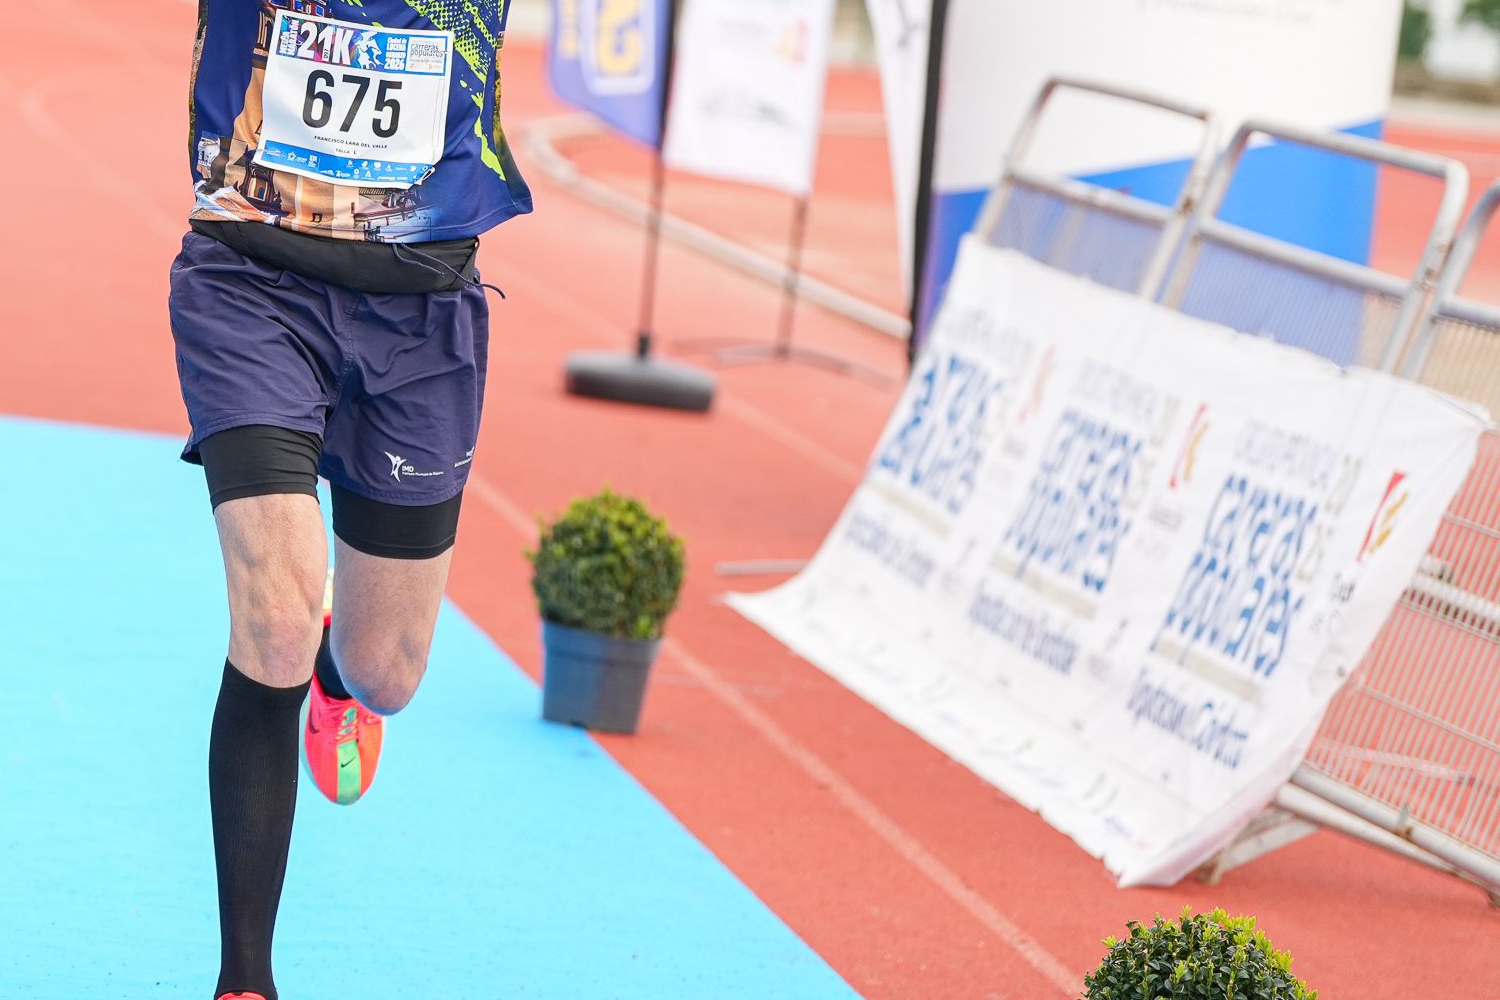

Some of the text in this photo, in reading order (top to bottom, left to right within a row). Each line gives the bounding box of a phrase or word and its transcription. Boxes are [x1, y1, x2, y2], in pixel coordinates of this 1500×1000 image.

[298, 22, 355, 65] 21K
[384, 58, 406, 70] 2026
[302, 69, 403, 138] 675
[314, 135, 345, 144] FRANCISCO
